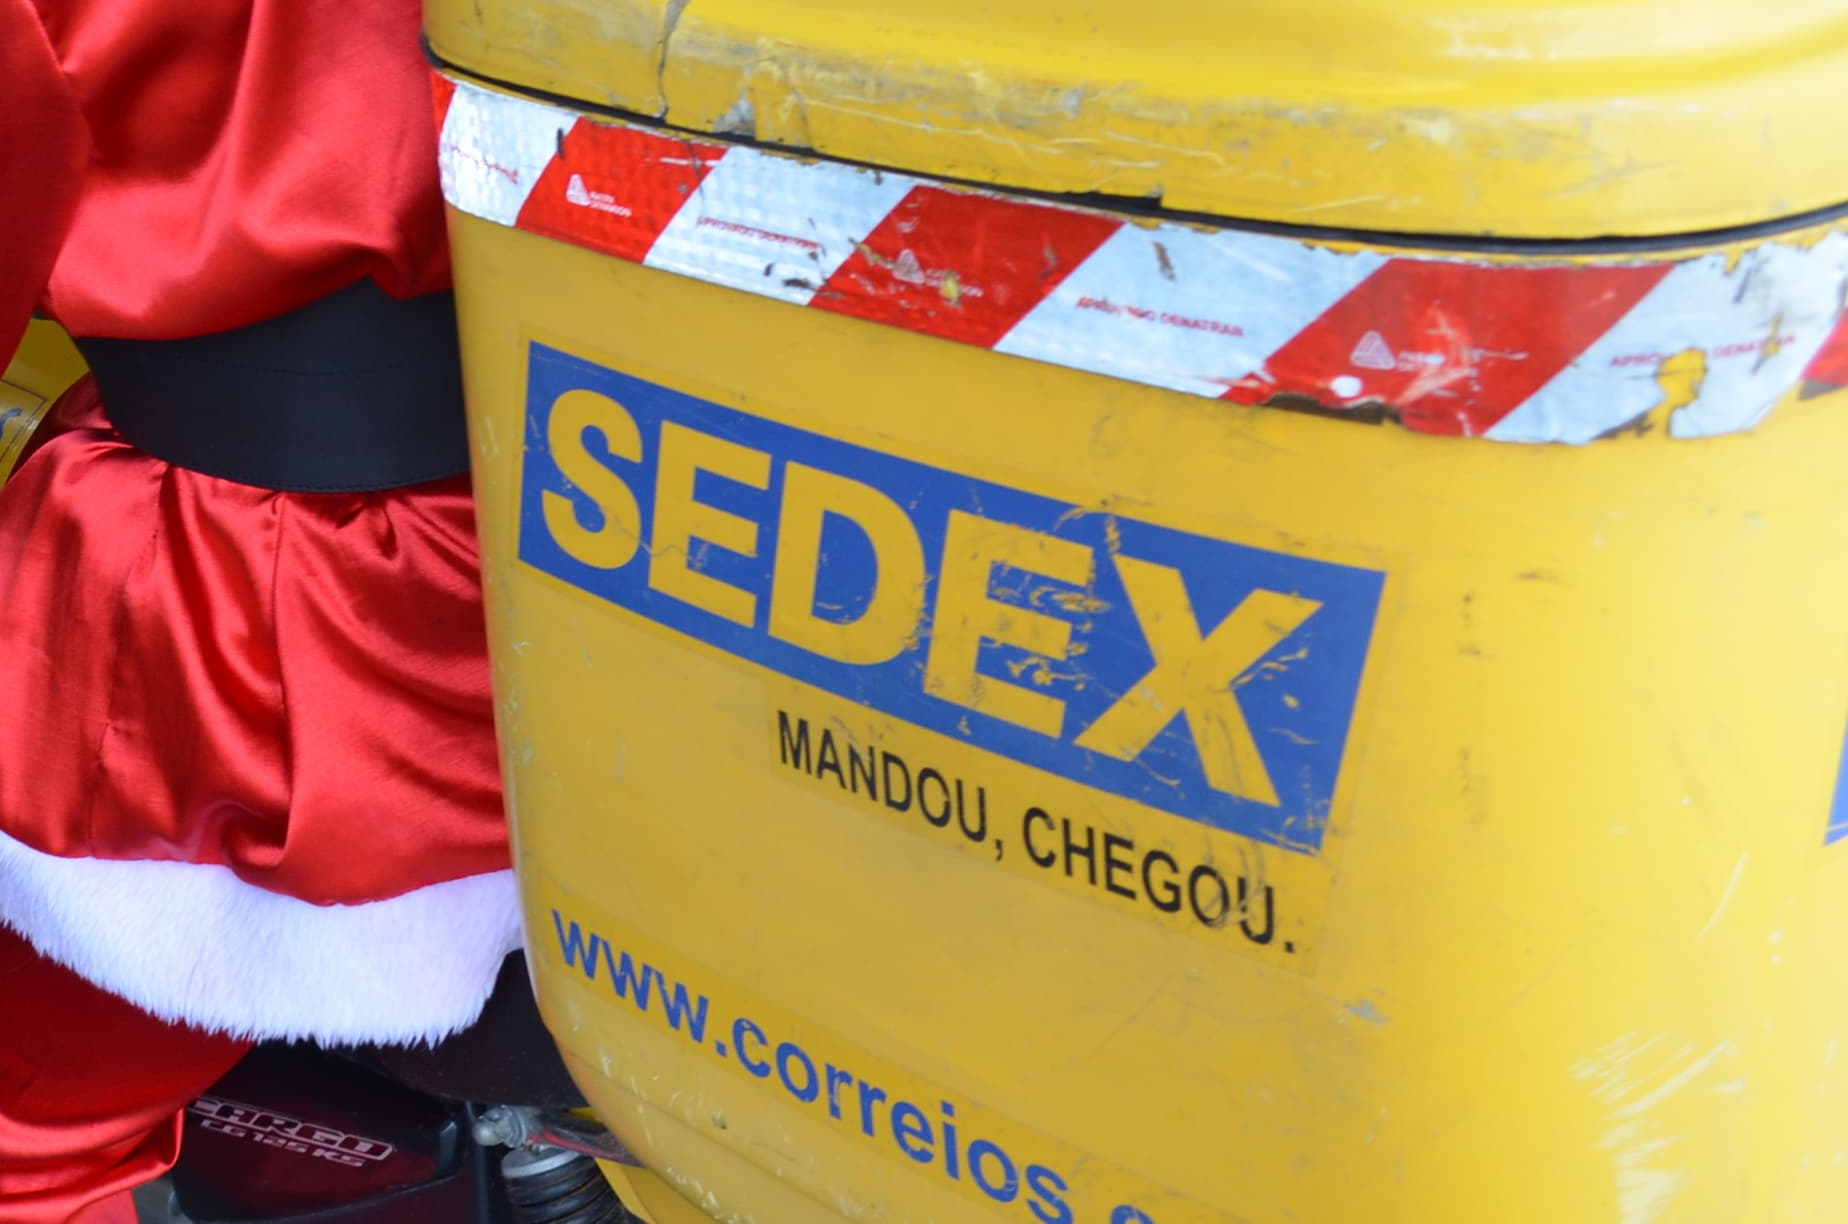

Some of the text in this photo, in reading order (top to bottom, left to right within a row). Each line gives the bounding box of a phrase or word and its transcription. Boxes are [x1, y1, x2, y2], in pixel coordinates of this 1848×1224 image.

[541, 388, 1324, 808] SEDEX
[778, 710, 1295, 954] MANDOU, CHEGOU.
[551, 908, 1158, 1224] www.correios
